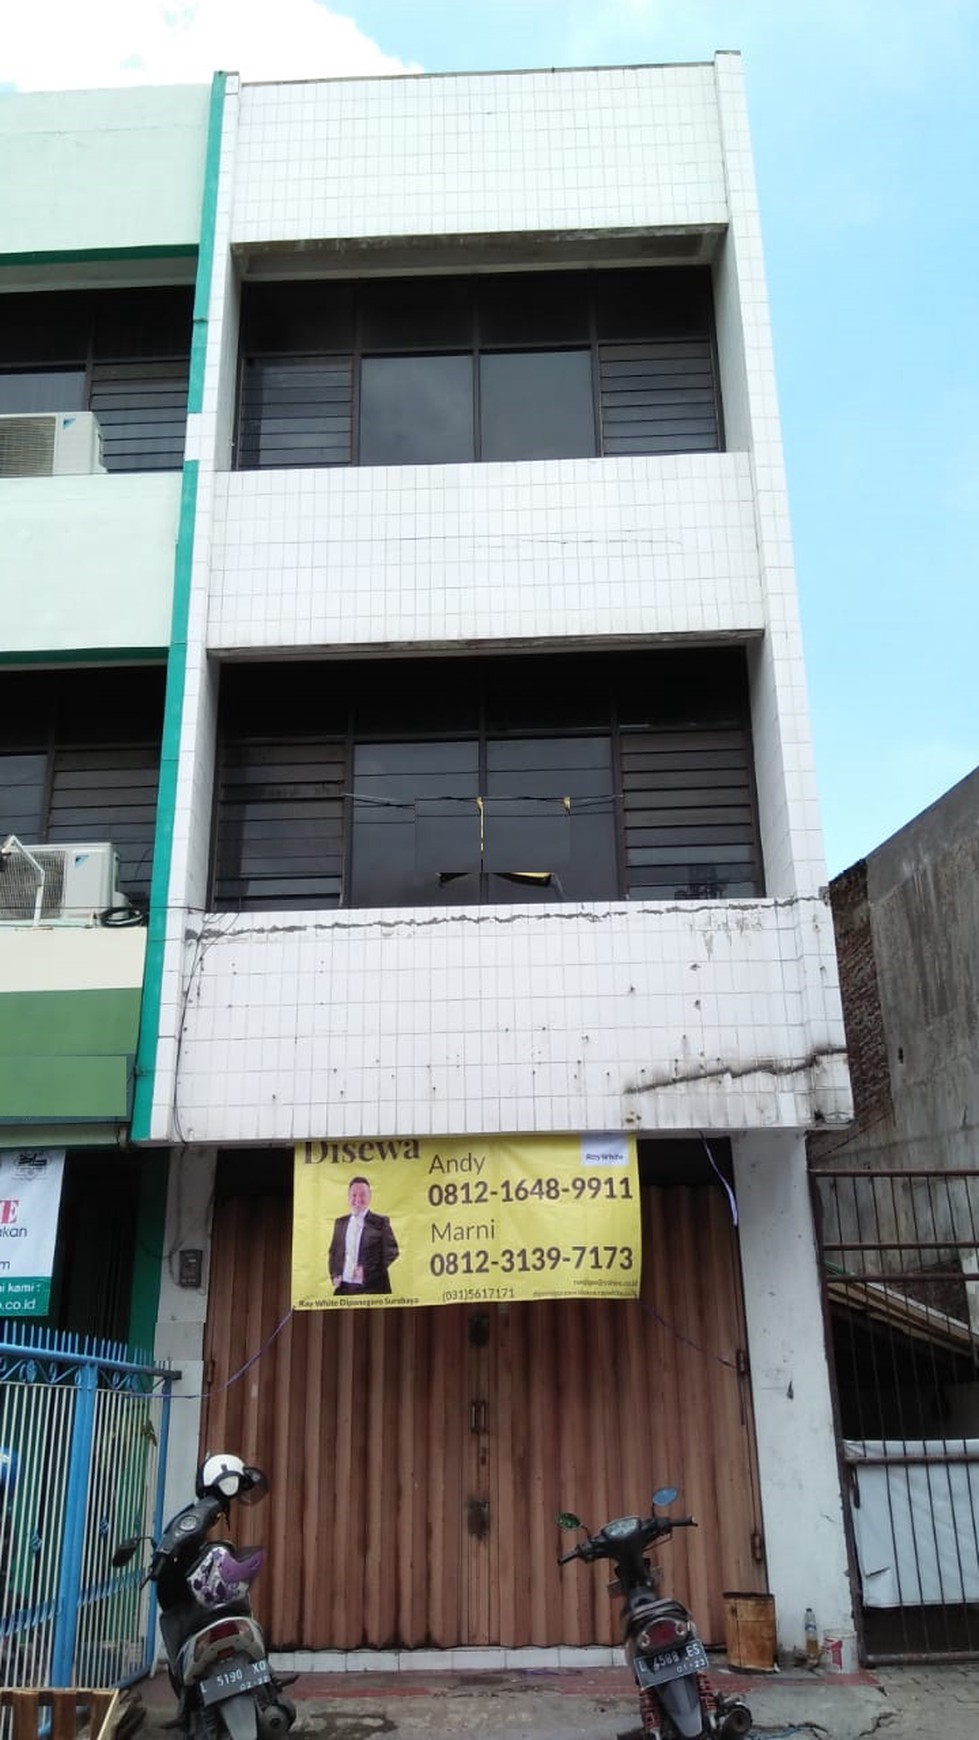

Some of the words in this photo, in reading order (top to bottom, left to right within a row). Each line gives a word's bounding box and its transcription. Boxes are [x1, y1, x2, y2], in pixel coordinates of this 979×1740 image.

[304, 1139, 420, 1165] Disewa
[428, 1152, 486, 1175] Andy
[428, 1176, 633, 1207] 0812-1648-9911
[431, 1219, 495, 1243] Marni
[430, 1246, 633, 1277] 0812-3139-7173
[315, 1299, 339, 1308] White
[442, 1288, 515, 1302] (031)5617171
[685, 1643, 701, 1658] ES
[200, 1681, 208, 1693] L
